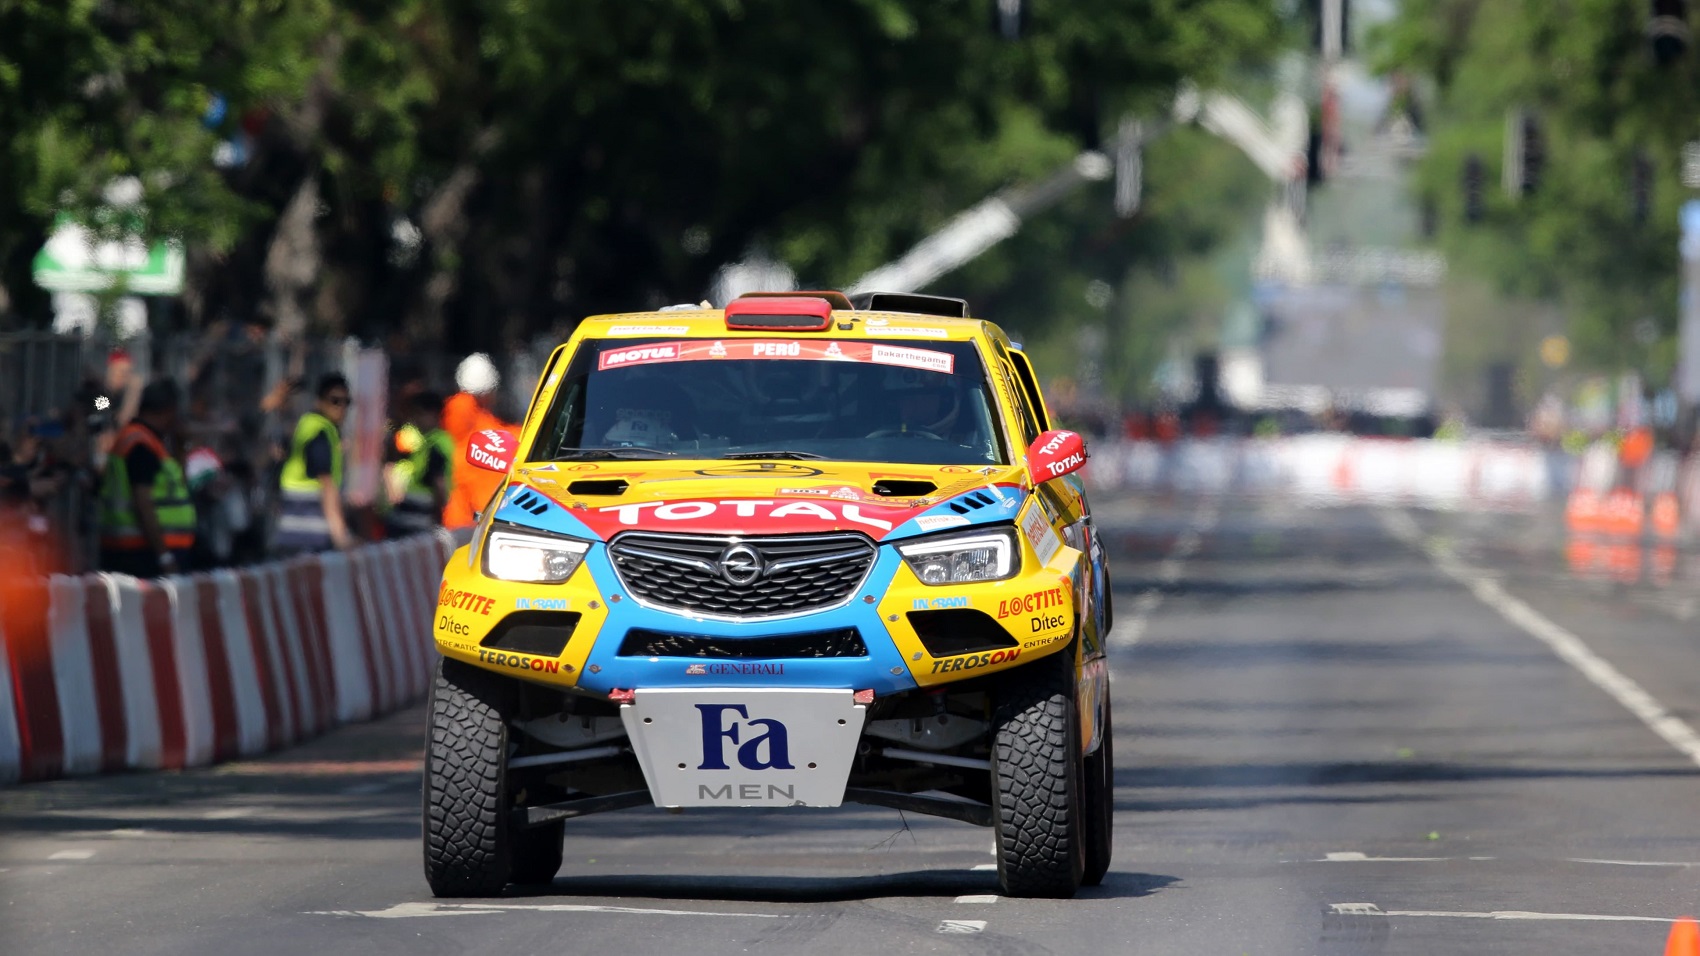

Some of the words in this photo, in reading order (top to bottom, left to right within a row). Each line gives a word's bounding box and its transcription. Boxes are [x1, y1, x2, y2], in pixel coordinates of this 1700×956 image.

[606, 347, 676, 365] MOTUL
[753, 341, 800, 356] PERÚ
[877, 349, 947, 364] Dakarthegame
[1039, 431, 1074, 455] TOTAL
[470, 443, 500, 470] TOTAL
[1046, 452, 1084, 476] TOTAL
[599, 500, 893, 531] TOTAL
[438, 588, 496, 616] LOCTITE
[998, 588, 1063, 619] LOCTITE
[479, 649, 560, 674] TEROSON
[709, 663, 785, 675] GENERALI
[931, 649, 1021, 675] TEROSON
[694, 703, 796, 770] Fa
[698, 784, 795, 800] MEN
